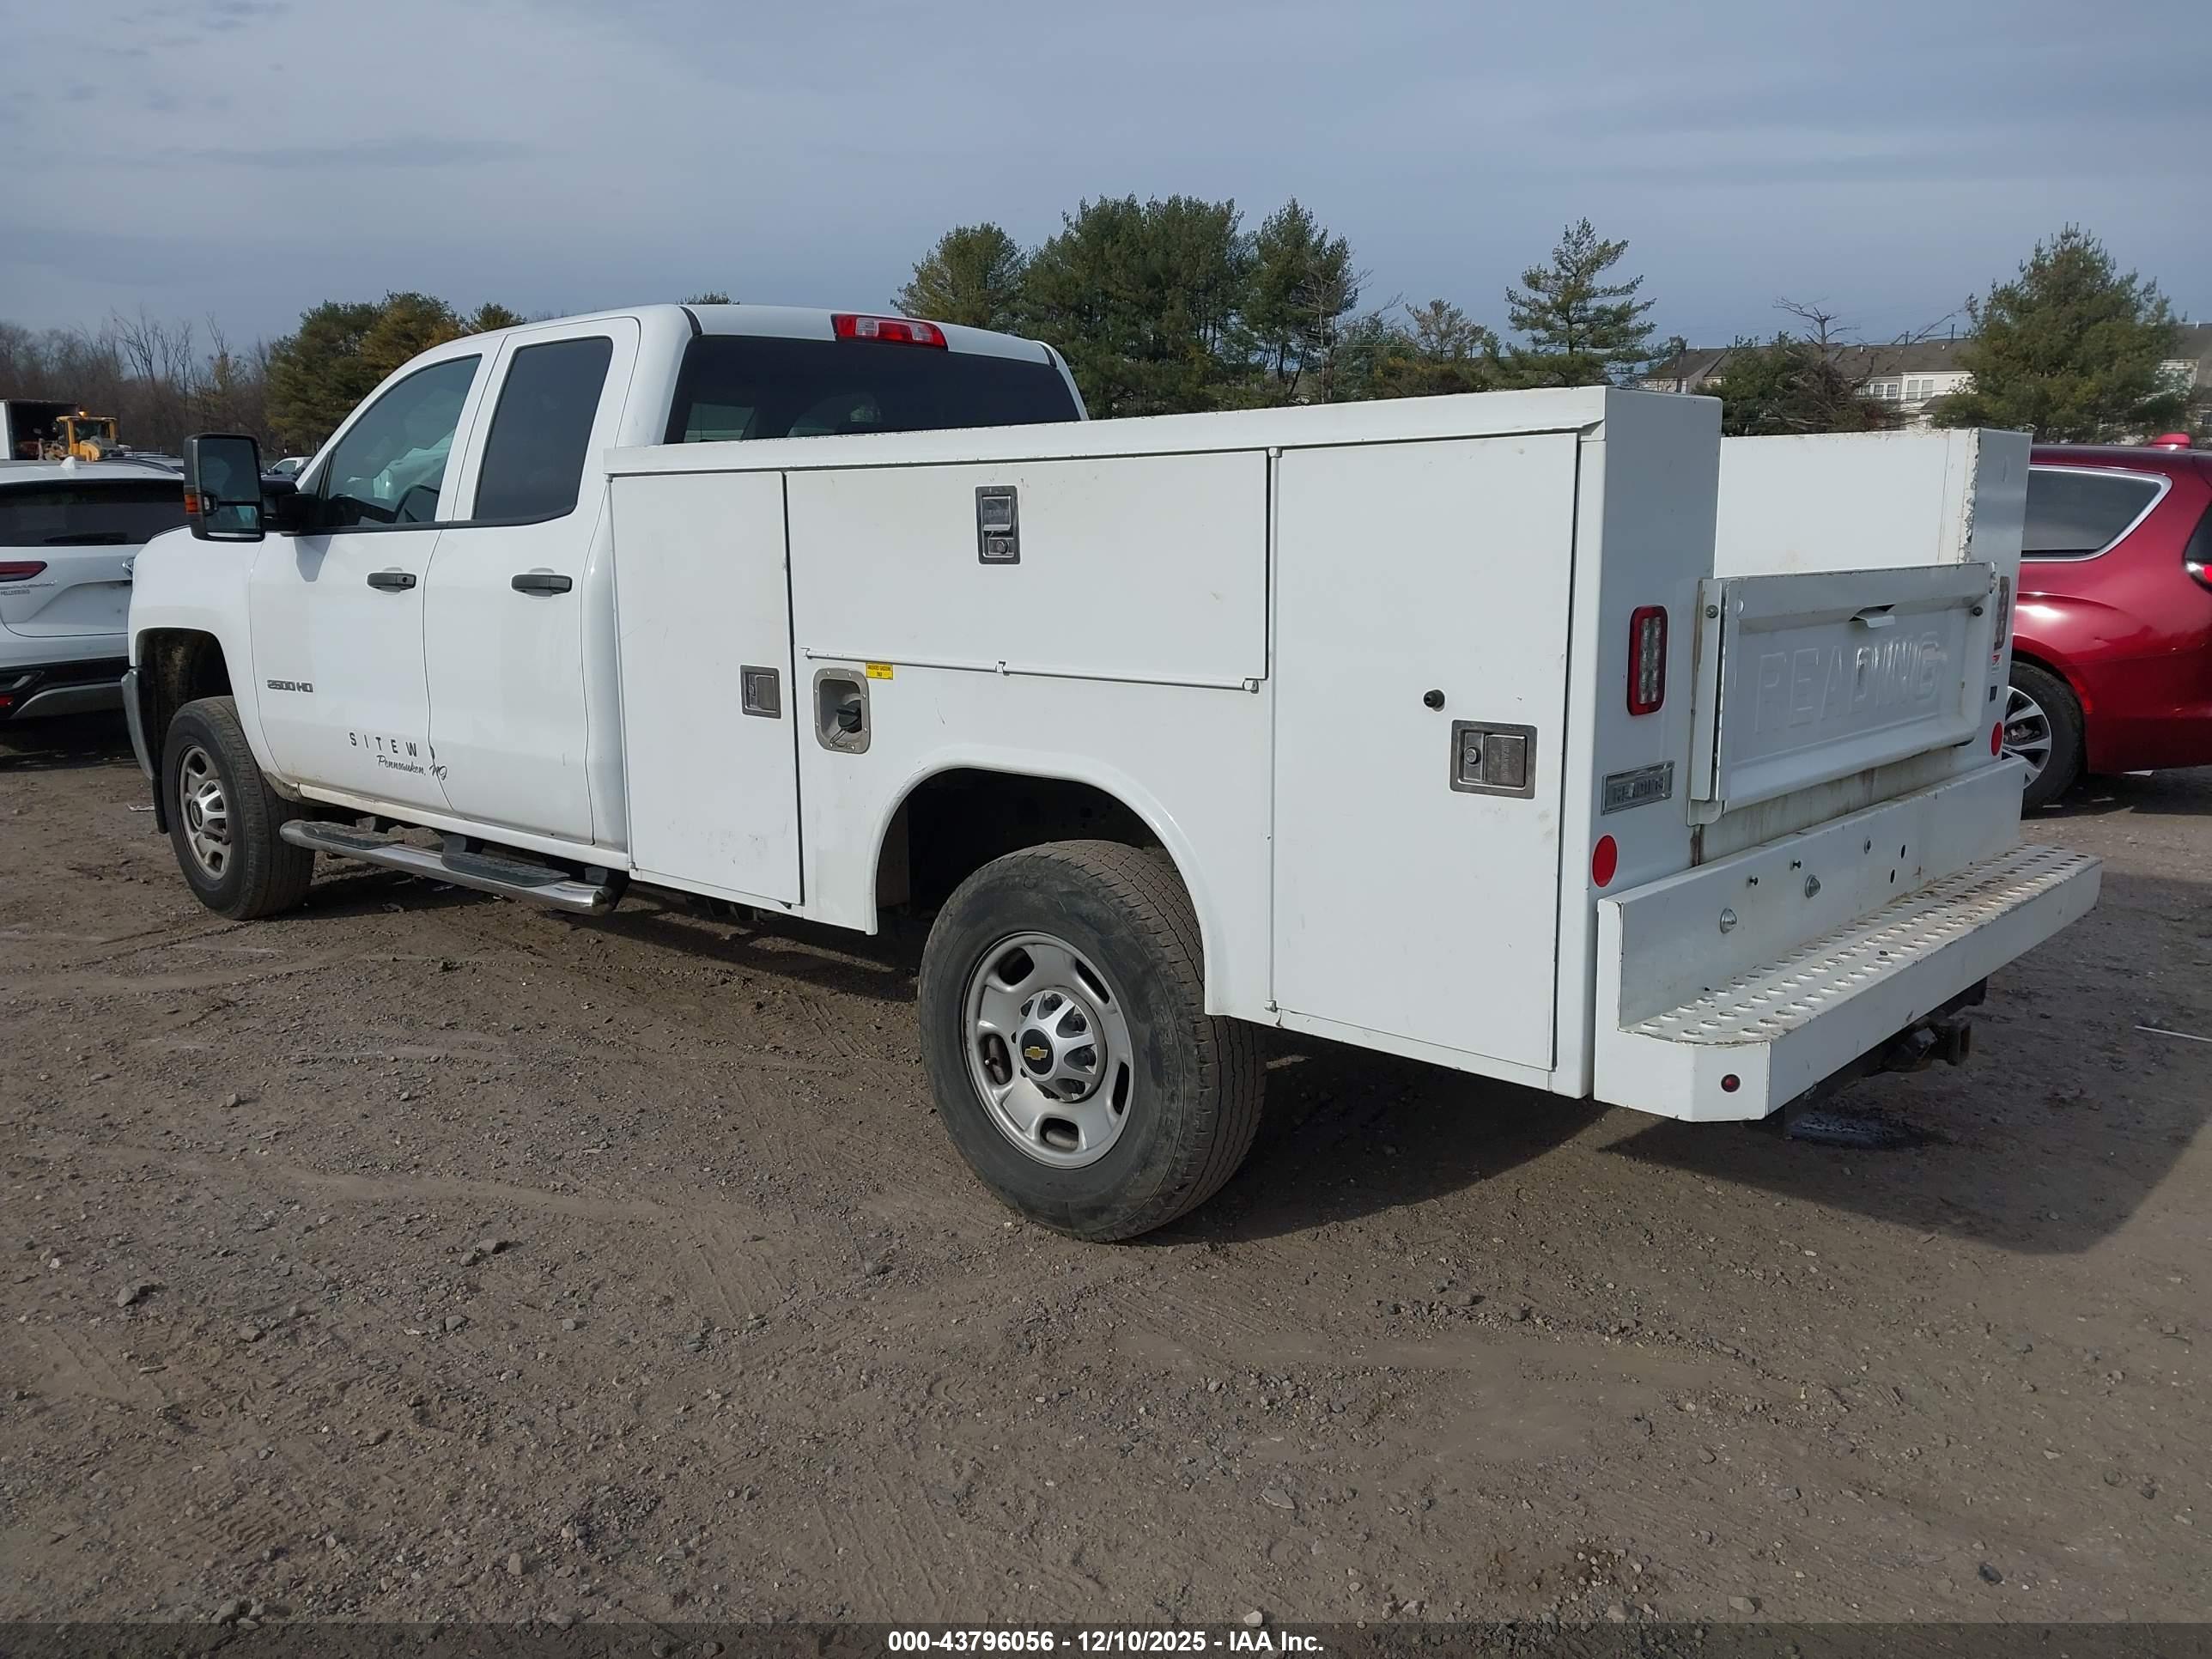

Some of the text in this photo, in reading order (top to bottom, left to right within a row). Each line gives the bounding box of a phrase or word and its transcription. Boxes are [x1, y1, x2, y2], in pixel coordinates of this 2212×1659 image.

[267, 679, 313, 692] 2500 HD
[1755, 632, 1941, 735] READING
